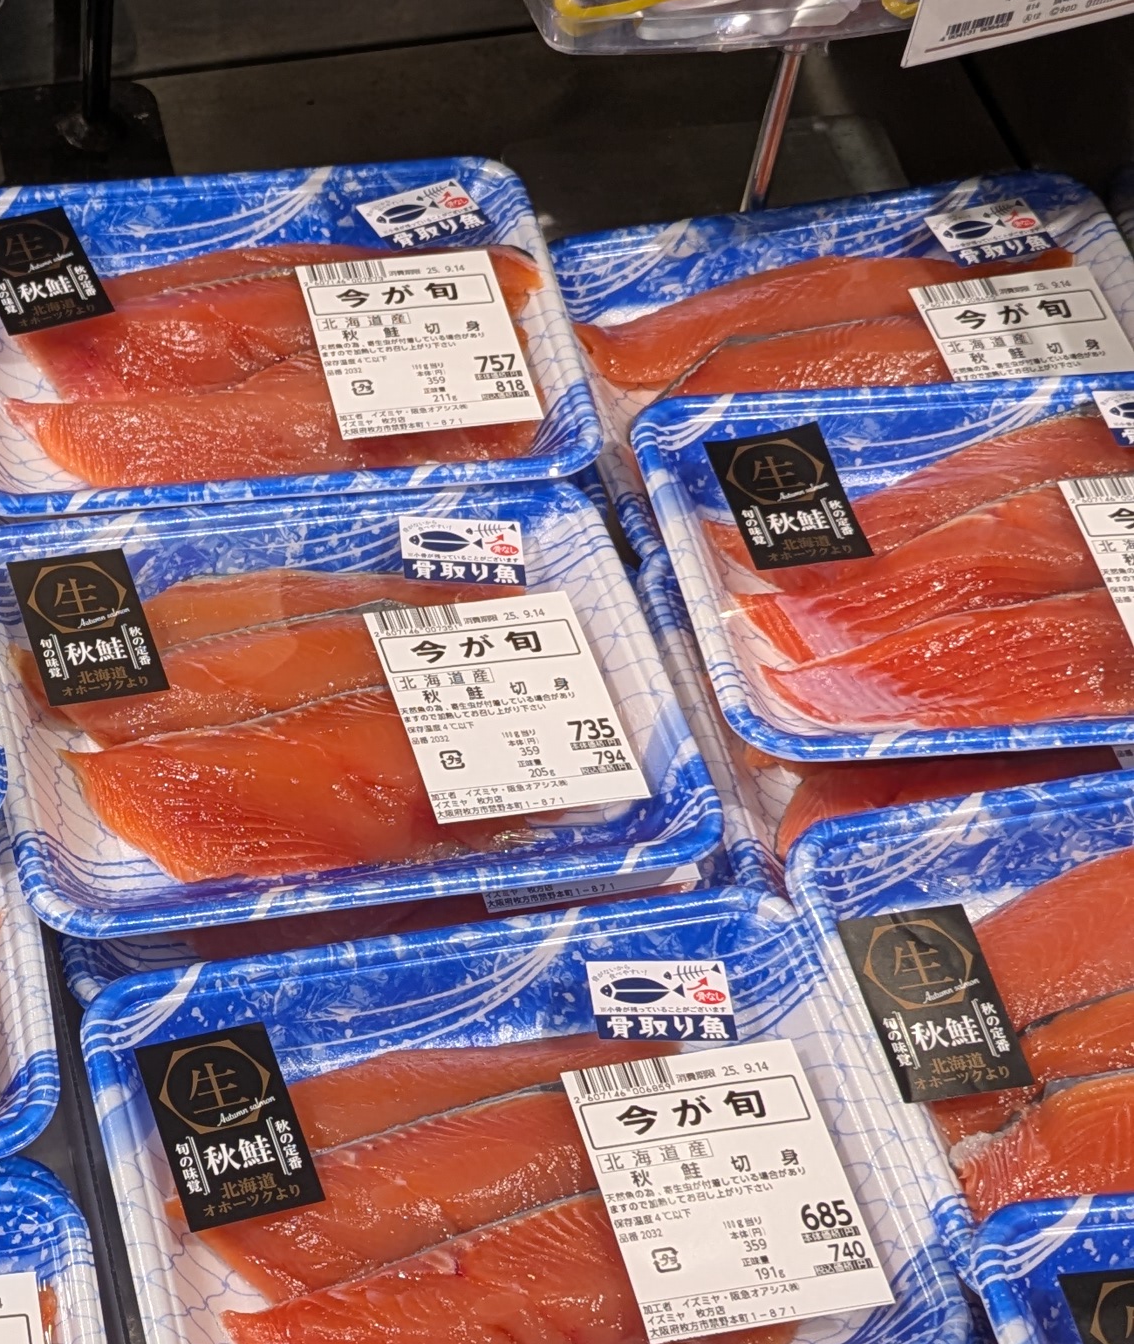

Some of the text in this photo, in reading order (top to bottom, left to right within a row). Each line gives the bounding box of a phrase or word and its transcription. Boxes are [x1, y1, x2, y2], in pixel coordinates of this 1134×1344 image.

[391, 209, 486, 248] 骨取り魚
[334, 280, 460, 309] 今が旬
[474, 353, 519, 372] 757
[494, 379, 526, 392] 818
[410, 558, 520, 586] 骨取り魚
[408, 628, 544, 665] 今が旬
[567, 717, 617, 741] 735
[592, 749, 627, 765] 794
[605, 1011, 729, 1041] 骨取り魚
[613, 1085, 769, 1138] 今が旬
[202, 1136, 276, 1175] 秋鮭
[797, 1199, 855, 1231] 685
[827, 1239, 868, 1262] 740
